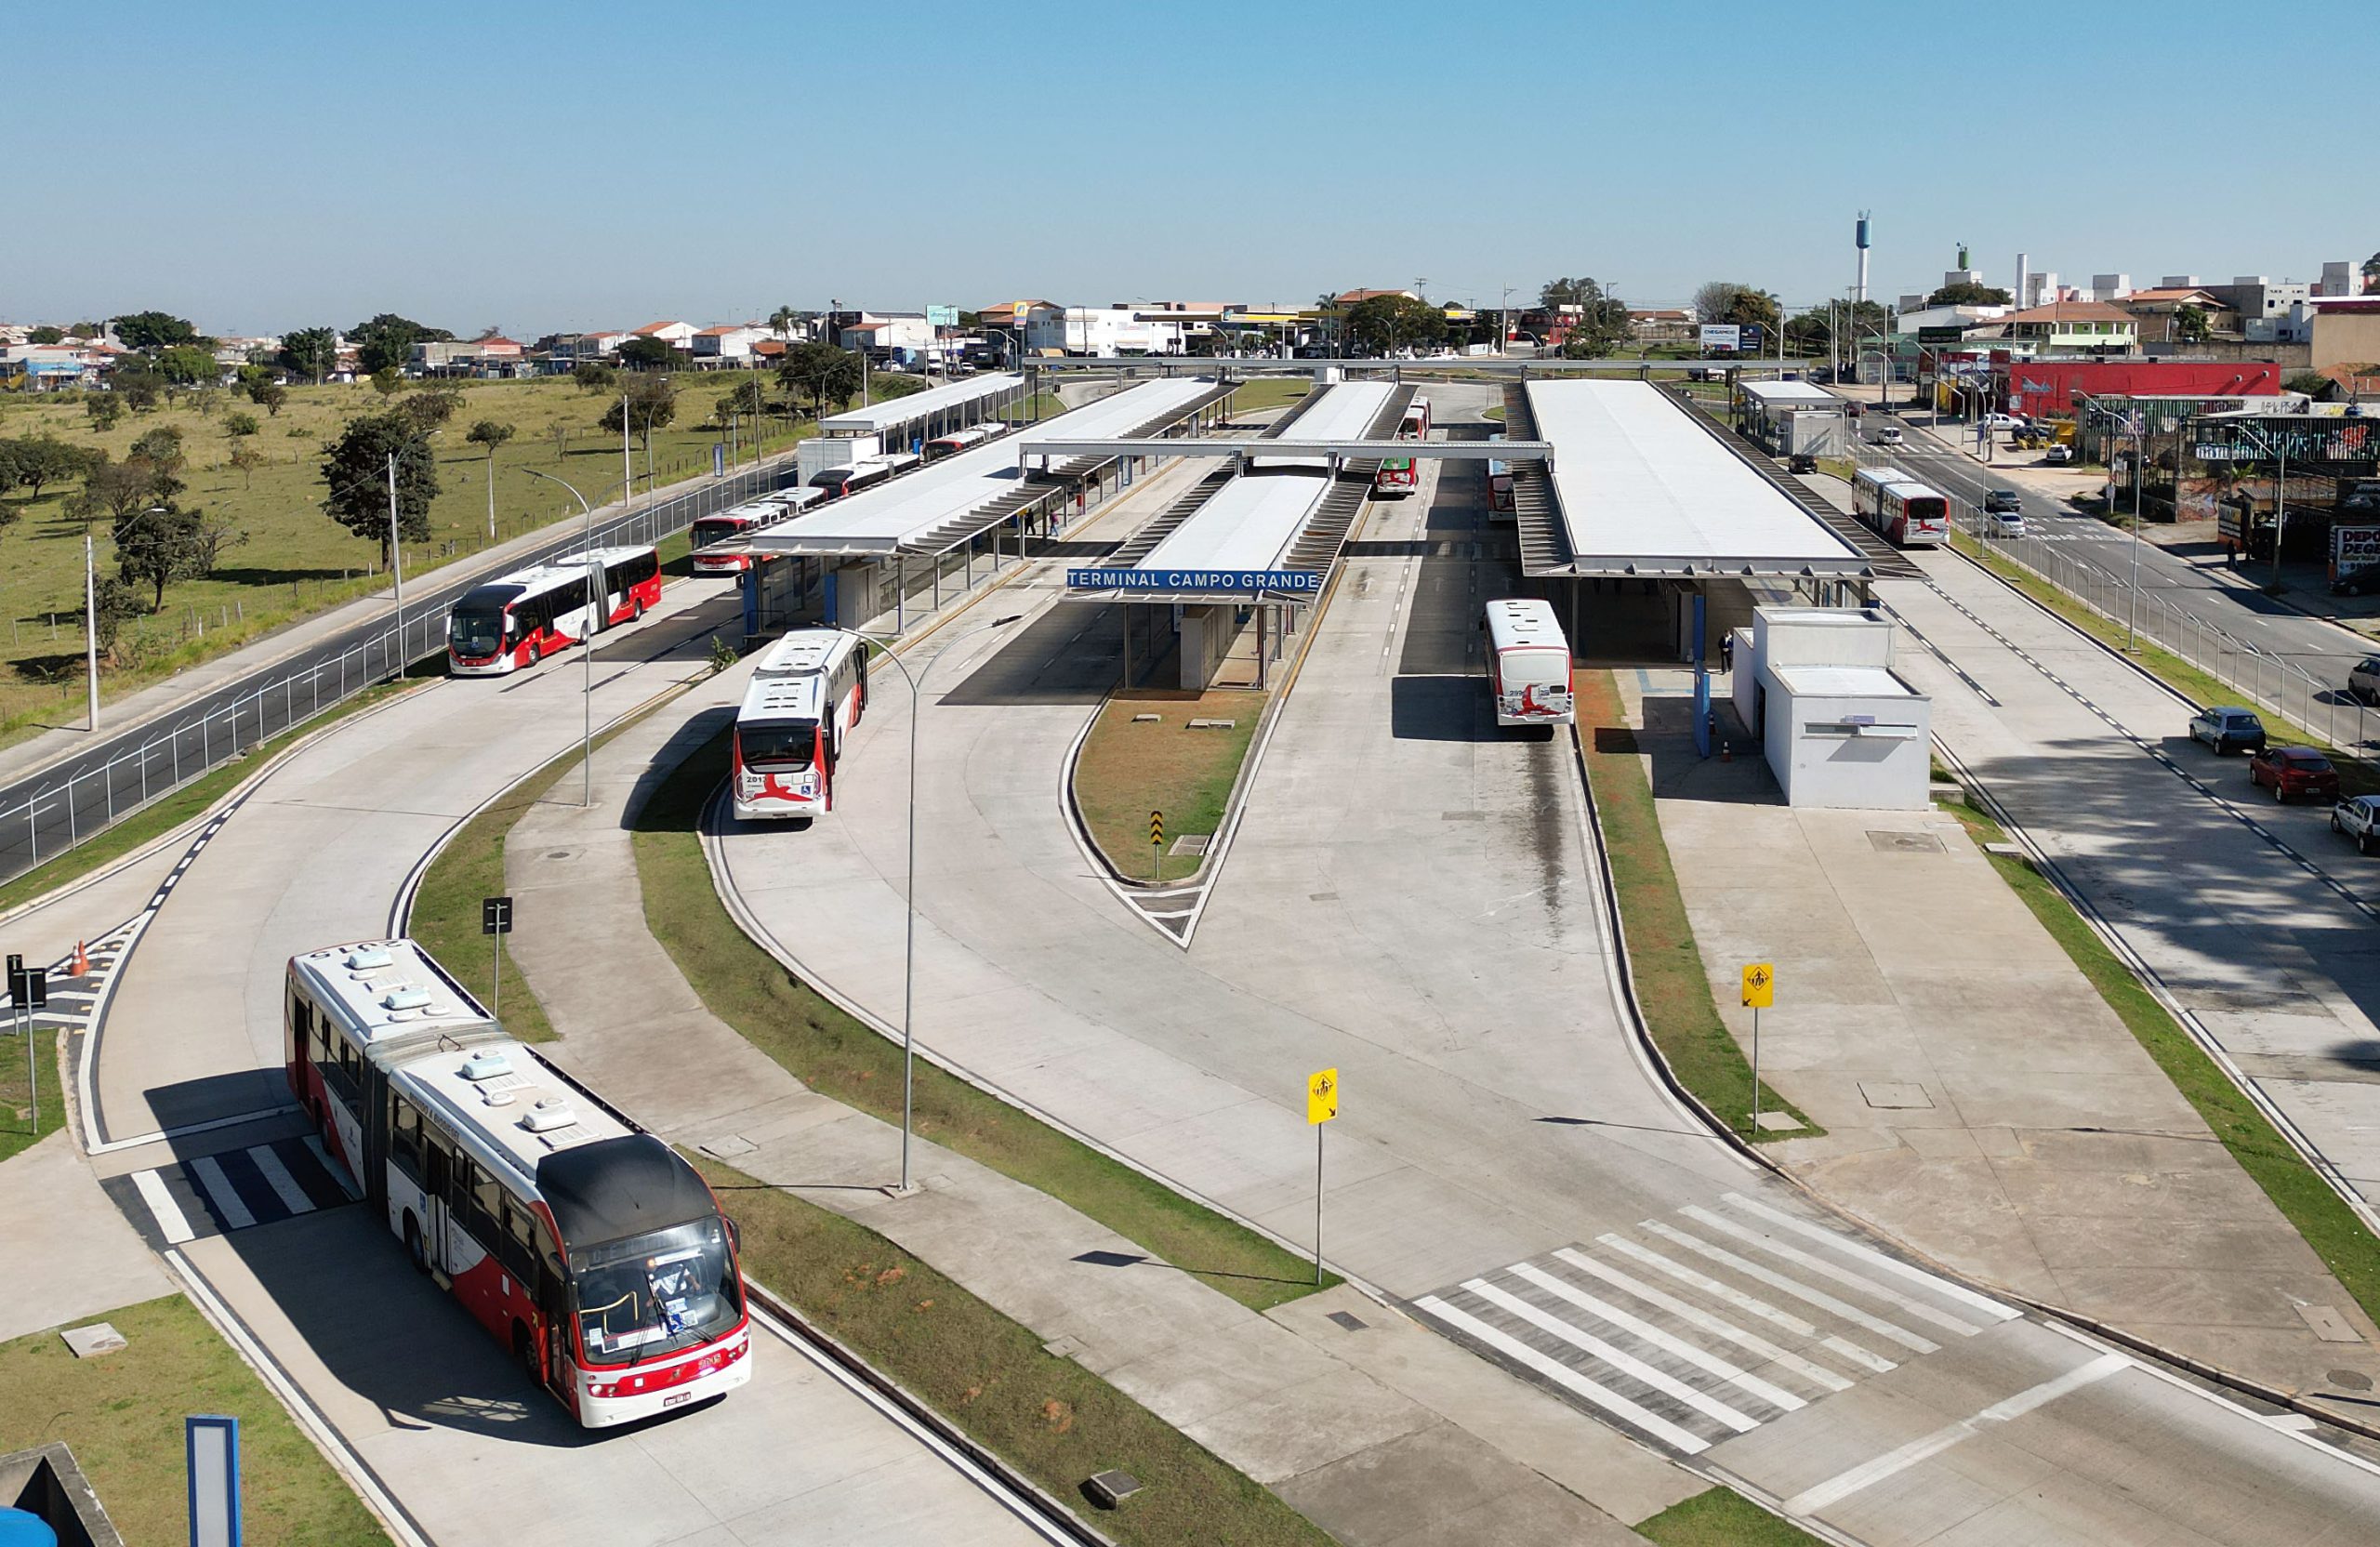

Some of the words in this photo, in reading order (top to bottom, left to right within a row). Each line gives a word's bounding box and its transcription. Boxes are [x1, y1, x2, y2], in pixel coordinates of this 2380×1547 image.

[1068, 572, 1159, 587] TERMINAL
[1169, 573, 1235, 588] CAMPO
[1241, 573, 1318, 589] GRANDE
